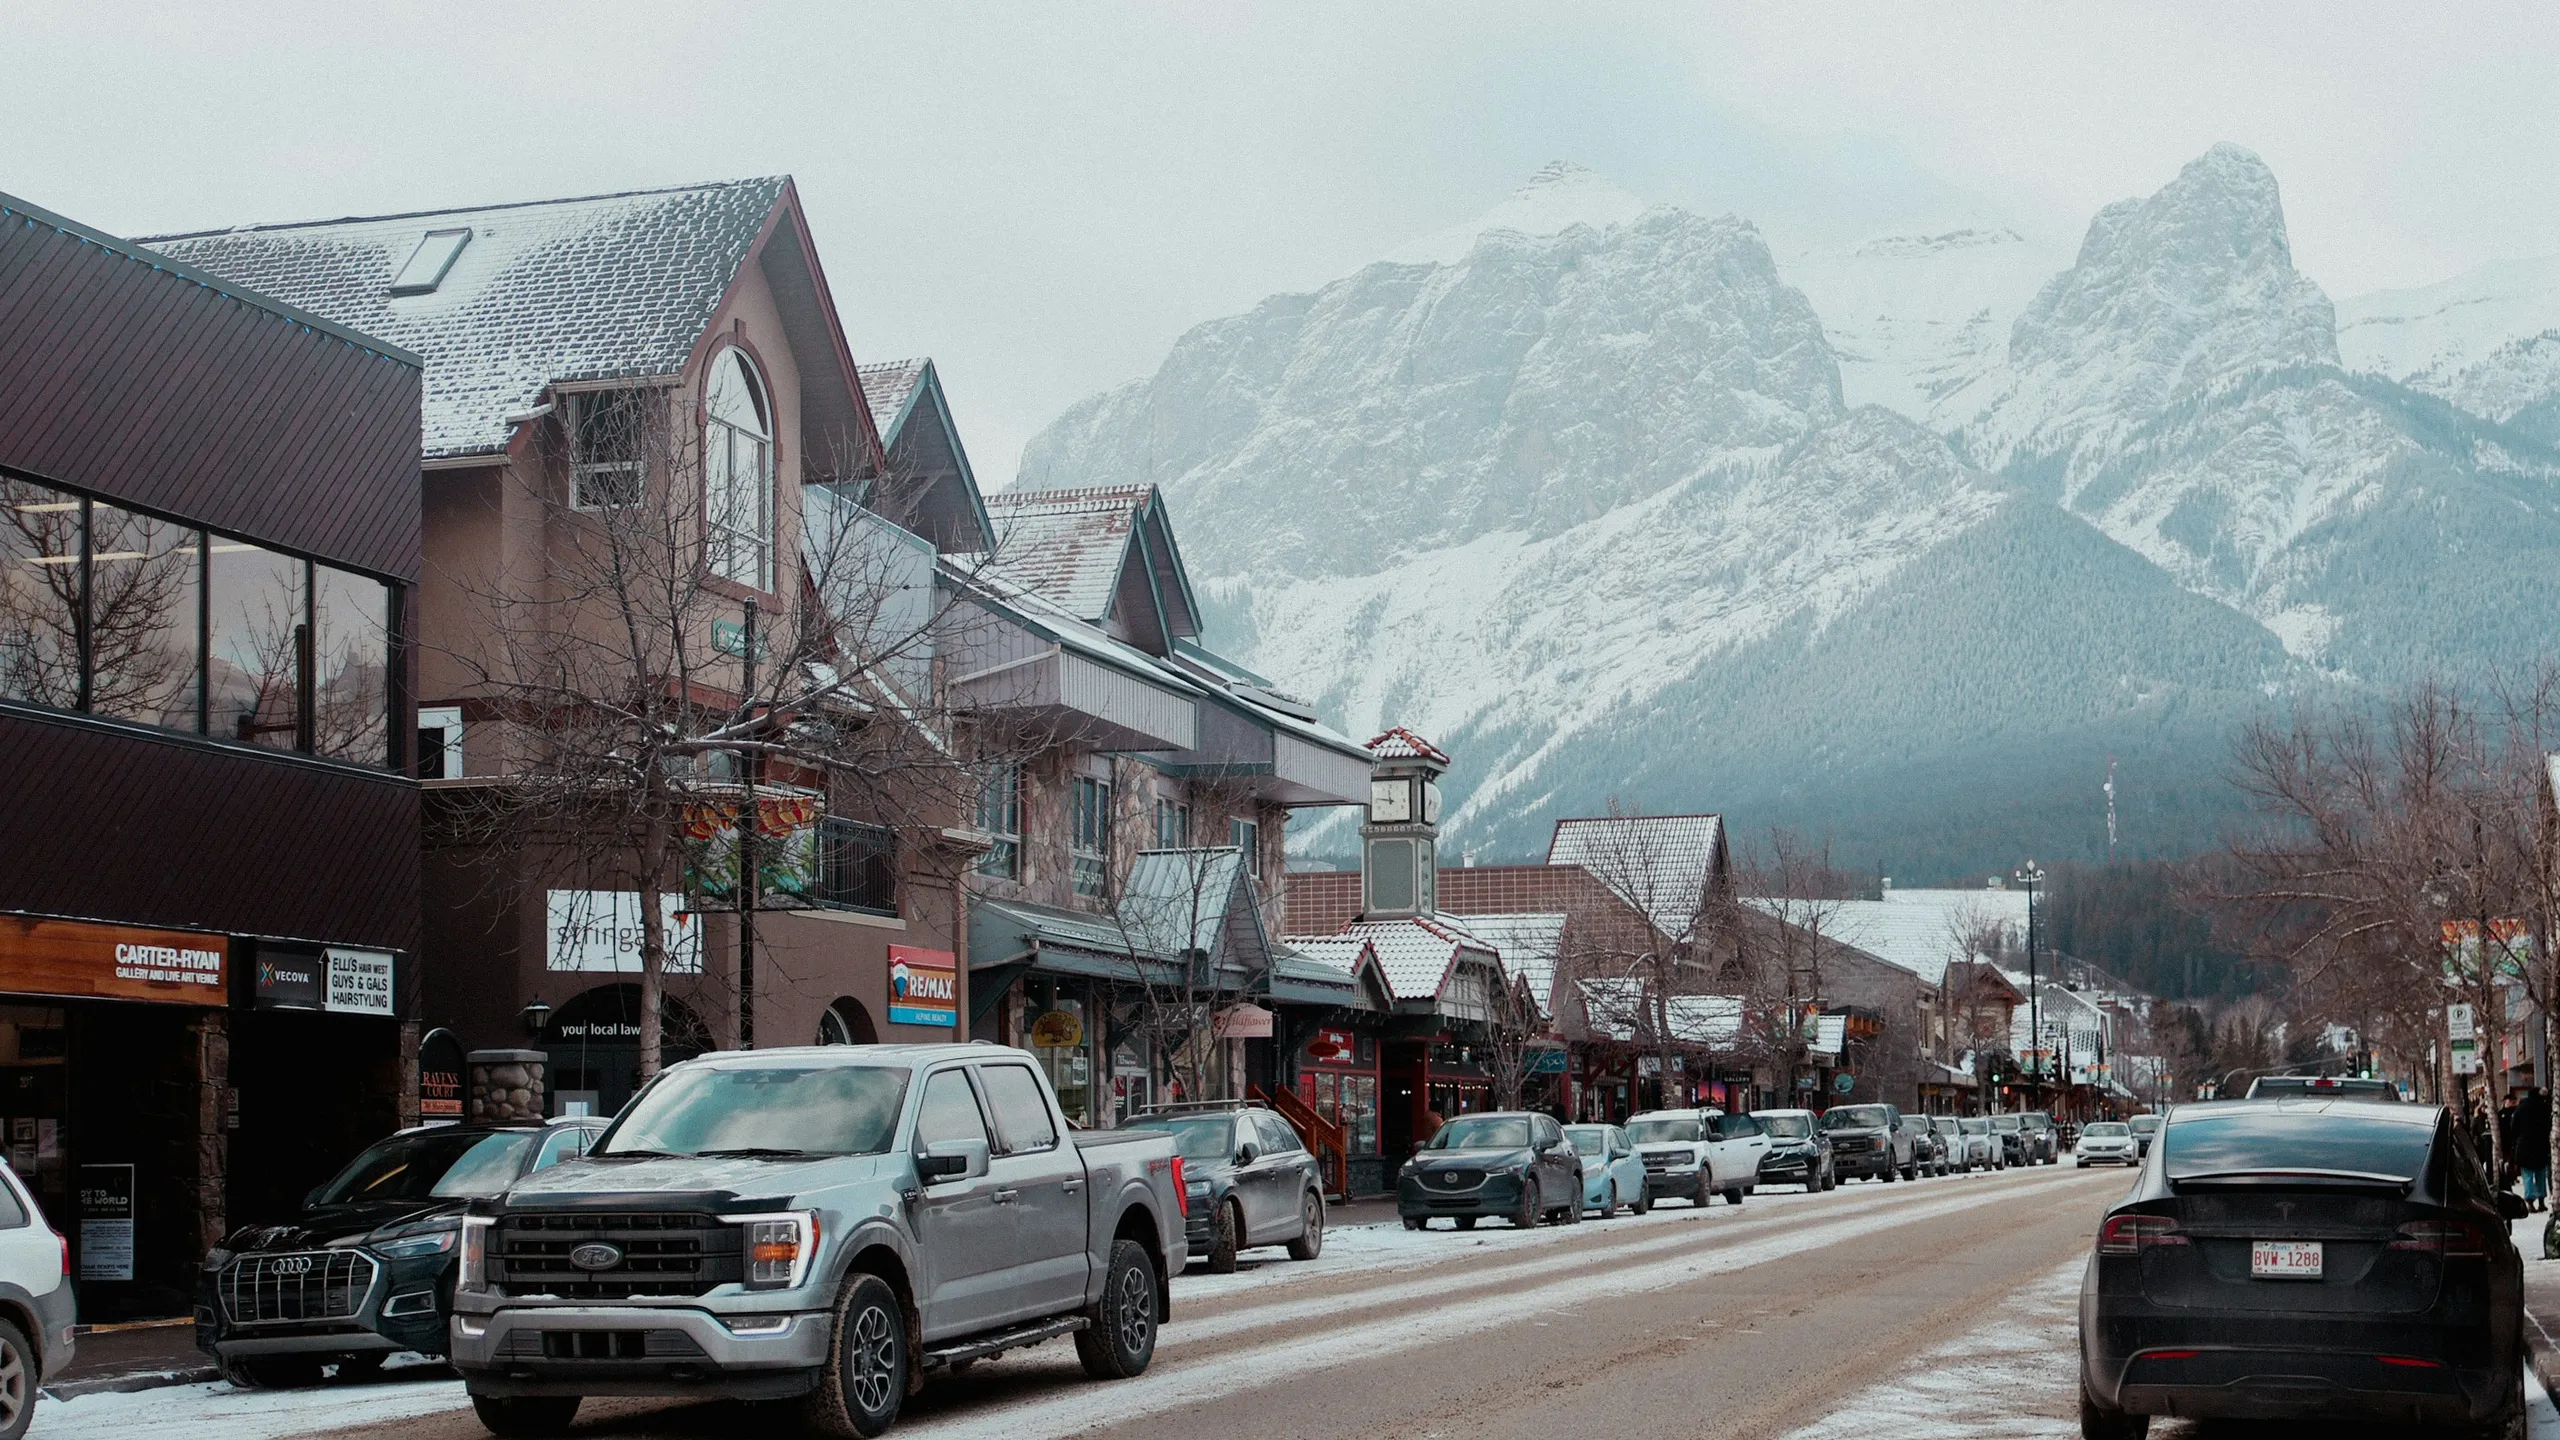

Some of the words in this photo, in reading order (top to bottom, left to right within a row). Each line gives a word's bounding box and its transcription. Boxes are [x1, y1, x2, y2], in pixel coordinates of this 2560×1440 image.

[115, 943, 220, 971] CARTER-RYAN
[116, 966, 149, 980] GALLERY
[150, 969, 165, 981] AND
[165, 970, 180, 982] LIVE
[180, 972, 196, 984] ART
[196, 973, 219, 985] VENUE
[358, 963, 372, 973] HAIR
[373, 964, 388, 974] WEST
[275, 971, 309, 983] VECOVA
[332, 976, 354, 989] GUYS
[357, 978, 364, 990] &
[366, 978, 387, 992] GALS
[909, 976, 953, 1000] RE/MAX
[332, 991, 388, 1008] HAIRSTYLING
[562, 1025, 587, 1037] your
[590, 1023, 617, 1036] local
[621, 1023, 668, 1036] laws.
[423, 1071, 459, 1085] RAVENS
[427, 1085, 454, 1097] COURT
[95, 1197, 128, 1205] WORLD
[2254, 1250, 2320, 1267] BVW-1288
